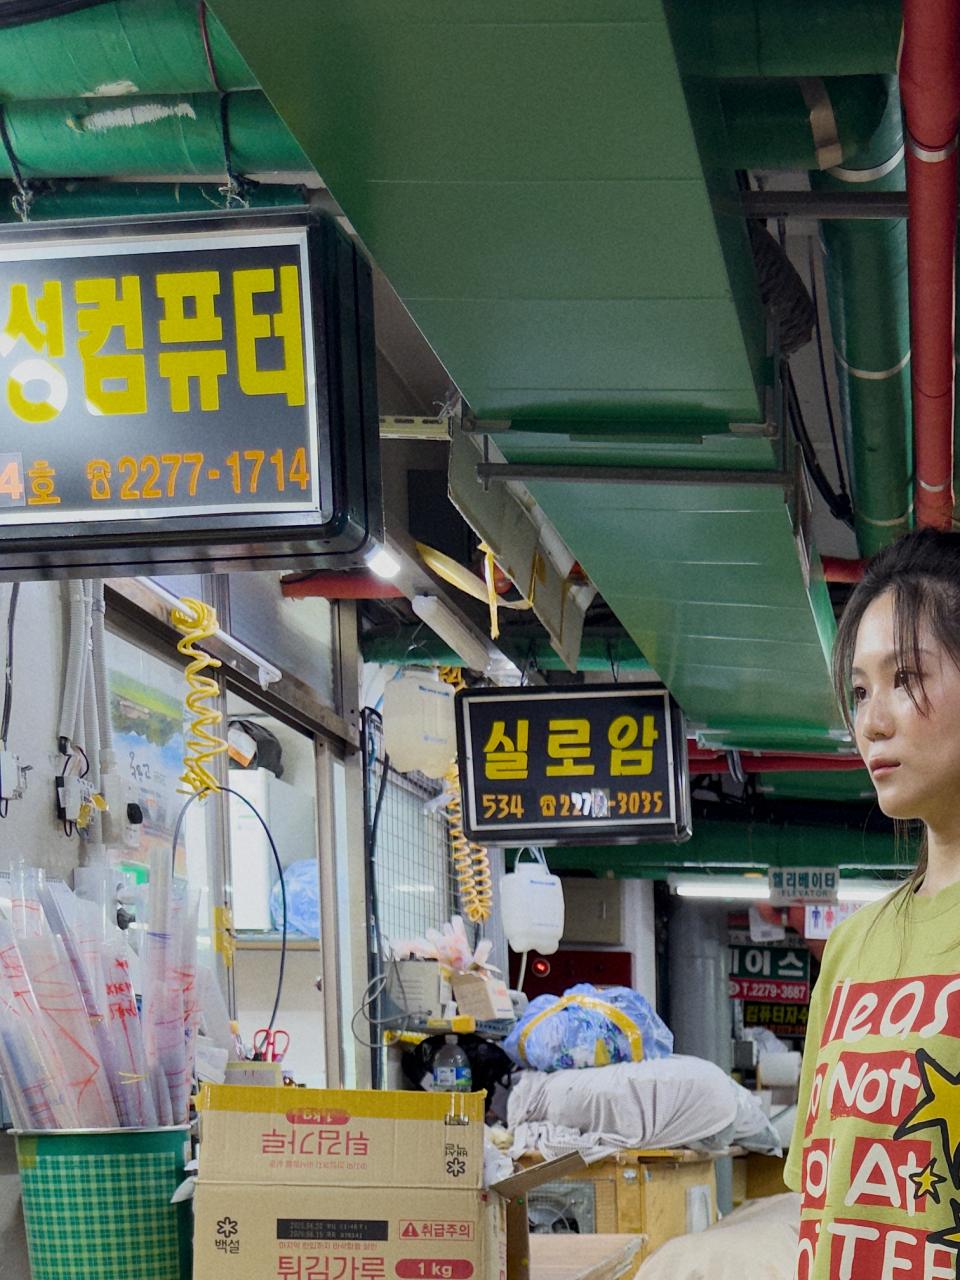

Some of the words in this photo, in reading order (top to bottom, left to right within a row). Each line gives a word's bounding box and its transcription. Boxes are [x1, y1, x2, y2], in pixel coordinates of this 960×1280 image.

[4, 265, 306, 424] 성컴퓨터
[118, 448, 310, 500] 2277-1714
[483, 715, 659, 781] 실로암
[482, 794, 524, 819] 534
[733, 949, 804, 977] 이스
[827, 1058, 921, 1116] Not
[261, 1128, 370, 1156] 튀김가루
[421, 1222, 471, 1238] 취급주의
[215, 1239, 240, 1254] 백설
[432, 1262, 453, 1278] kg
